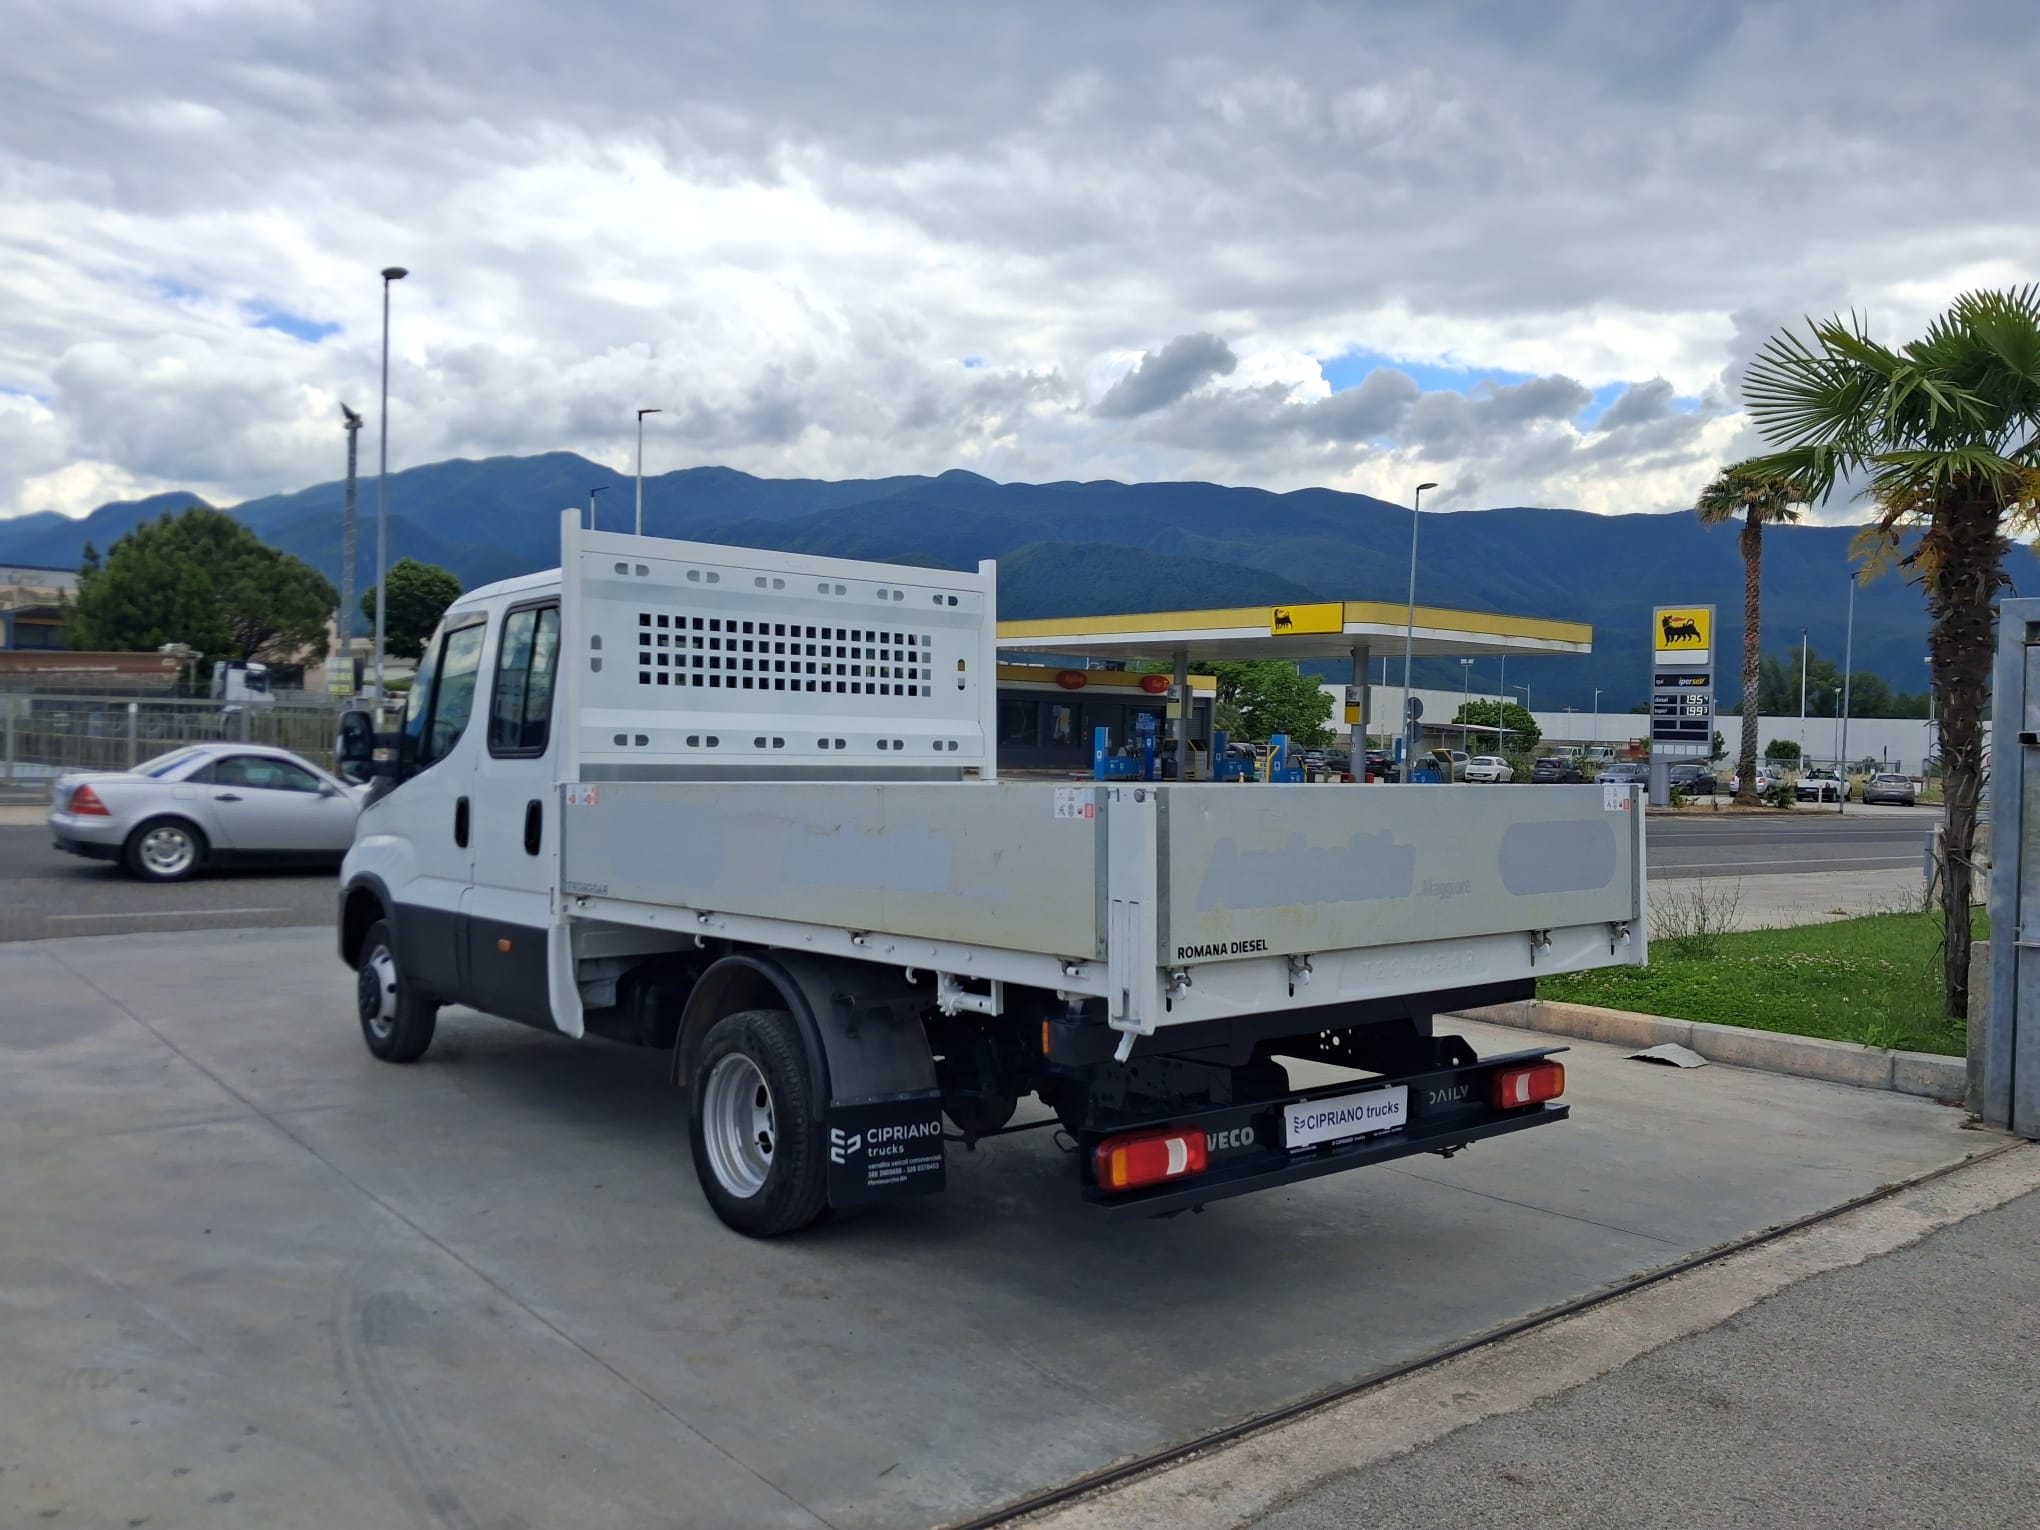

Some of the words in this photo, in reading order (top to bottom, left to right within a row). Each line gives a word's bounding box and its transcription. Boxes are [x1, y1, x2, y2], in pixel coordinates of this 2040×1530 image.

[1678, 677, 1706, 686] iperself
[1177, 942, 1228, 959] ROMANA
[1230, 939, 1268, 954] DIESEL
[1429, 1084, 1469, 1105] DAILY
[1306, 1106, 1364, 1130] CIPRIANO
[1366, 1101, 1400, 1119] trucks
[867, 1121, 941, 1143] CIPRIANO
[1206, 1126, 1255, 1152] VECO
[867, 1144, 904, 1157] trucks
